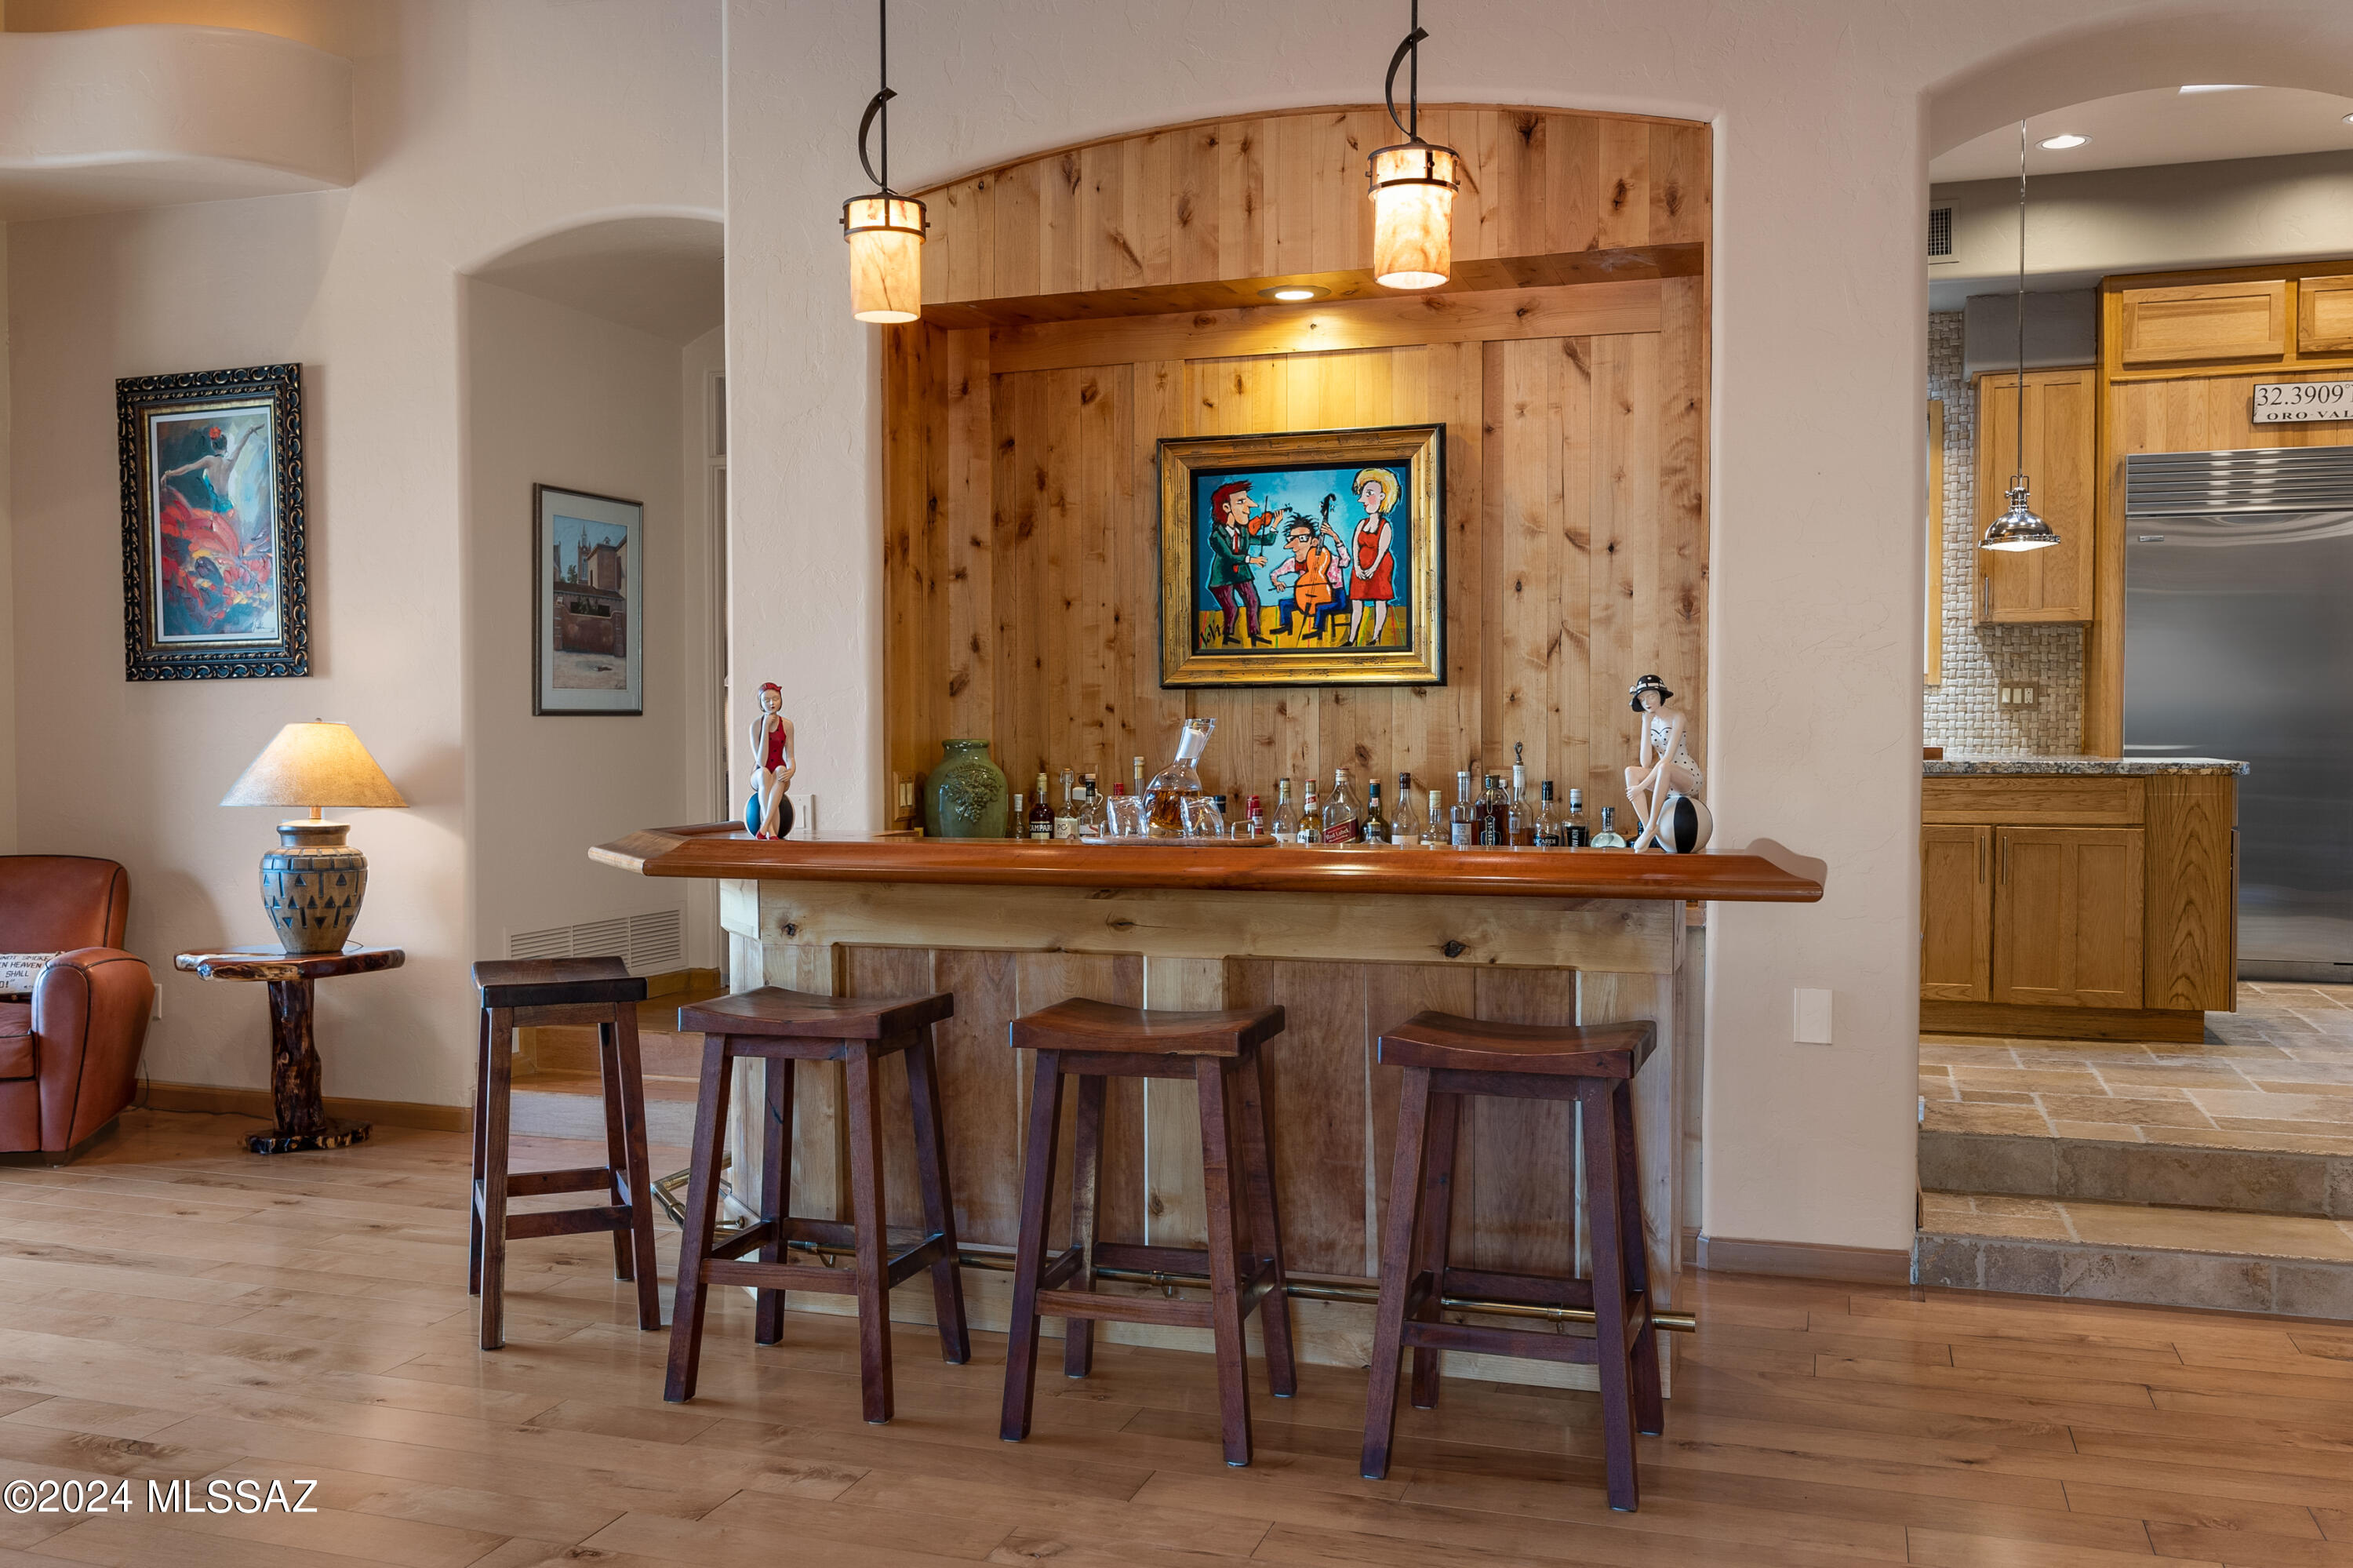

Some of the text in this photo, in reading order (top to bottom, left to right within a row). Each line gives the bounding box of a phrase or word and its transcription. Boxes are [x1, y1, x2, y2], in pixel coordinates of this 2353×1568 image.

[2257, 384, 2353, 406] 32.3909°
[2267, 411, 2308, 420] ORO
[5, 970, 29, 978] SHALL
